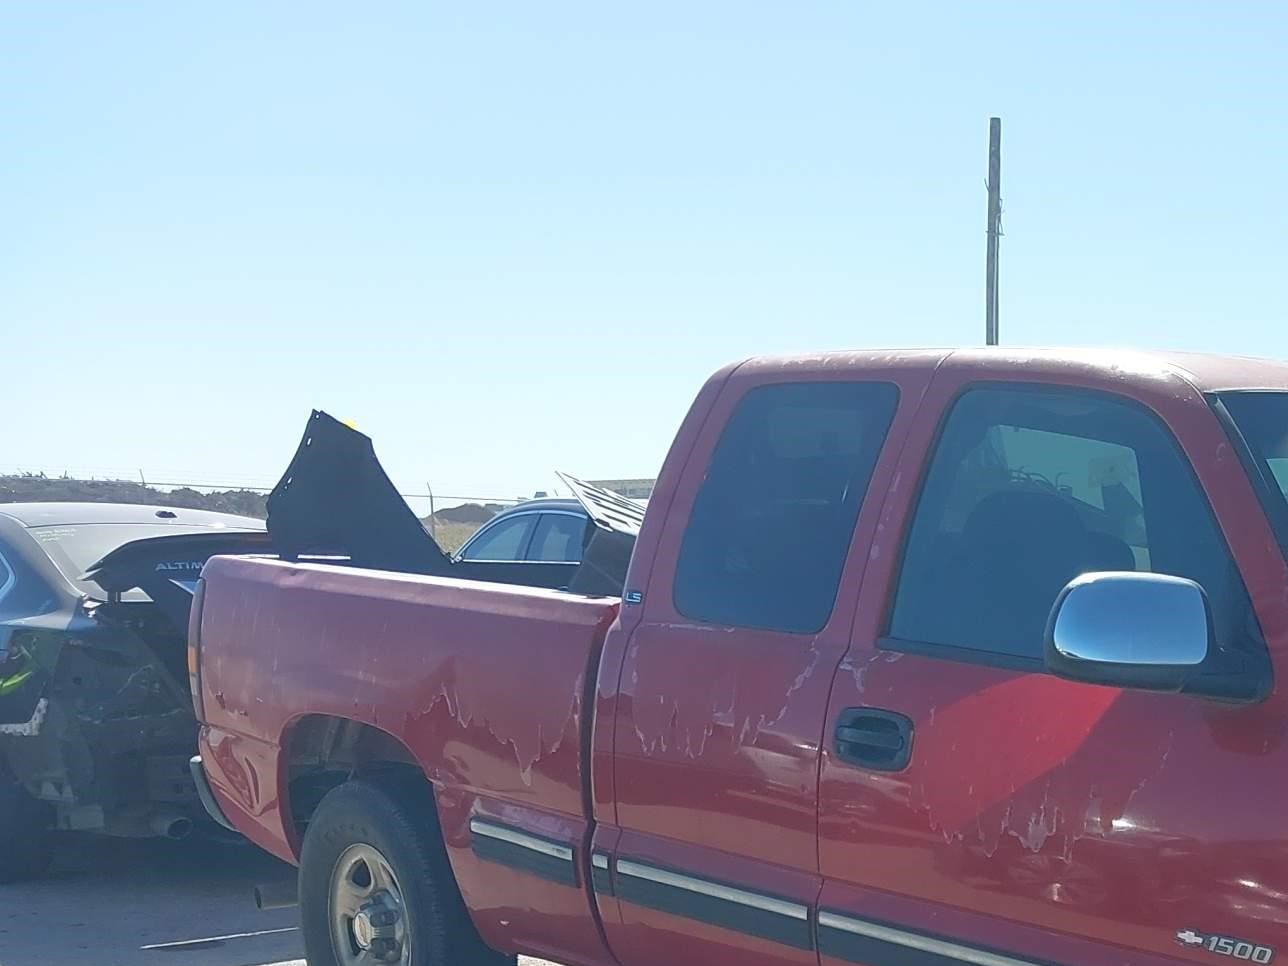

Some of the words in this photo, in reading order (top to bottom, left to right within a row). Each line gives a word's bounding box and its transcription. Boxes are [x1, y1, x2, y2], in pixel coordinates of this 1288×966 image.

[154, 560, 203, 572] ALTIM
[625, 591, 642, 603] LS
[1207, 936, 1273, 965] 1500
